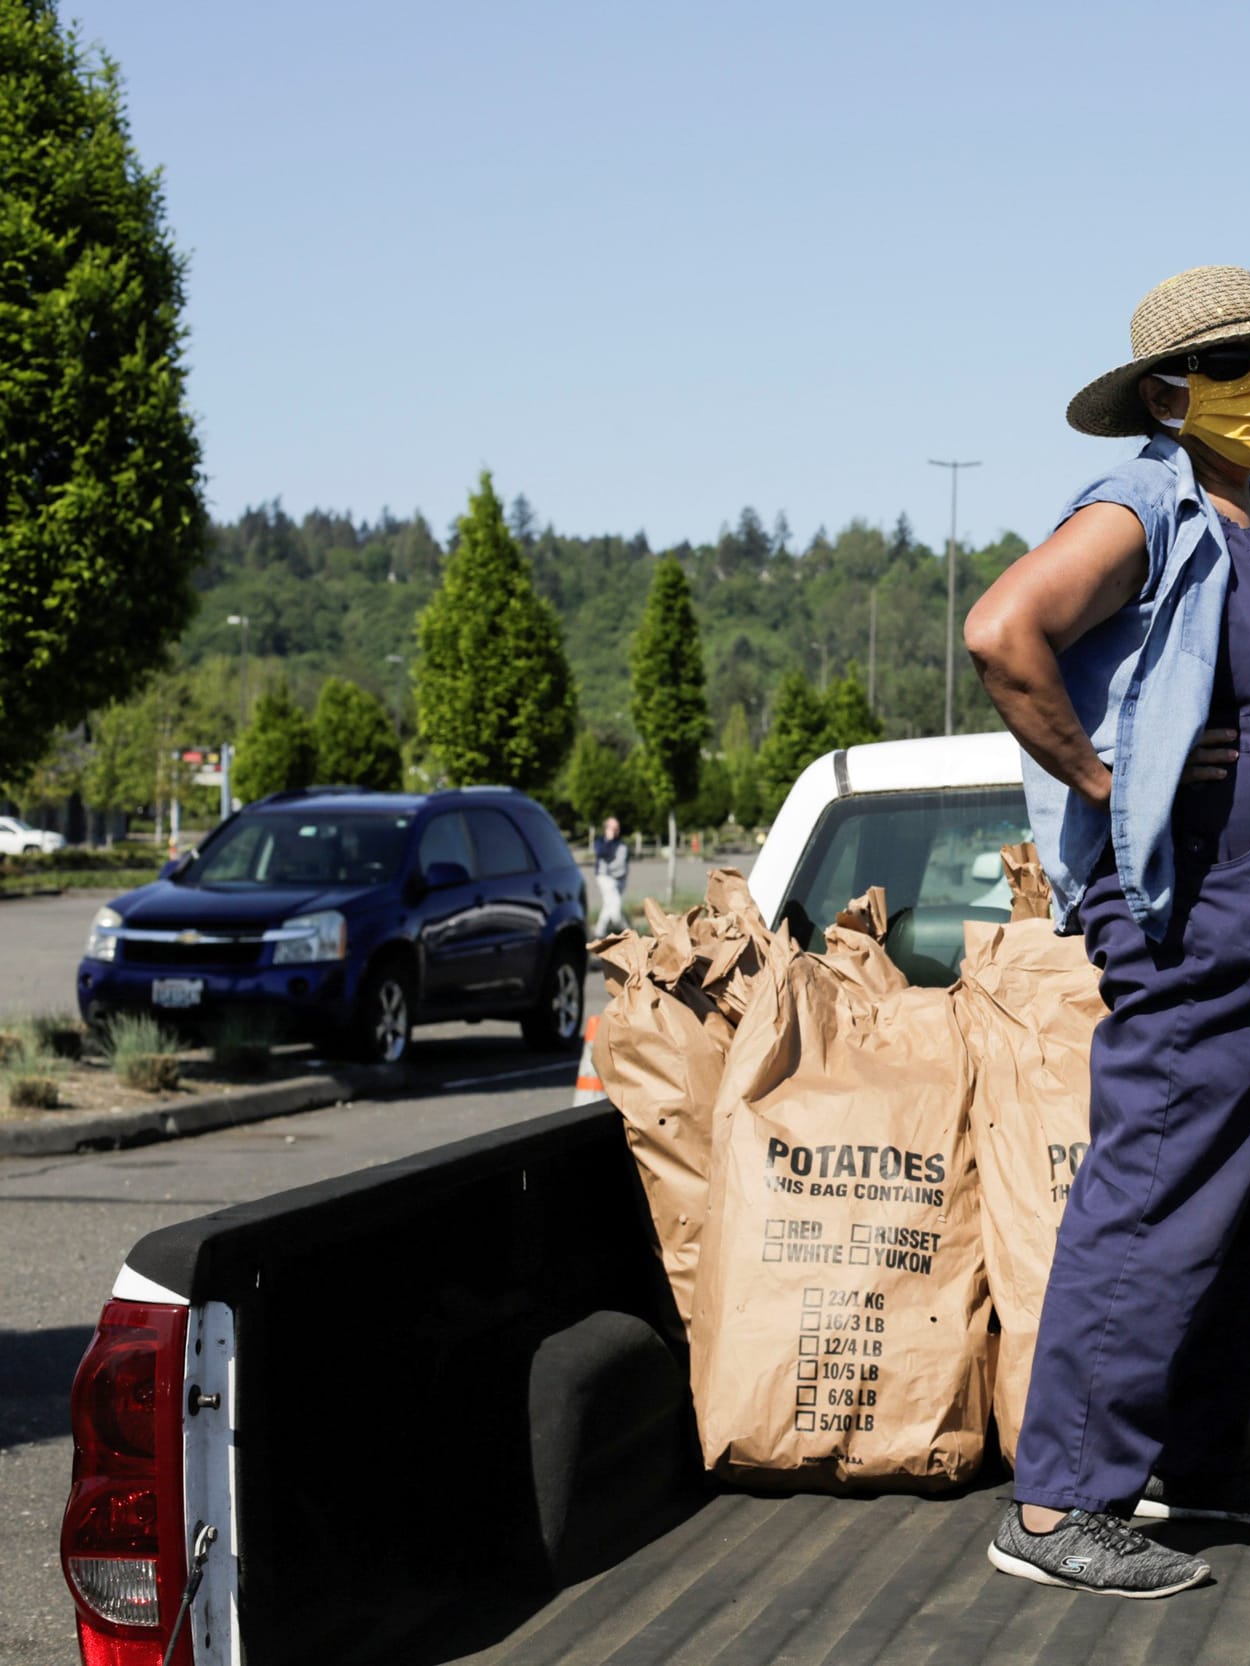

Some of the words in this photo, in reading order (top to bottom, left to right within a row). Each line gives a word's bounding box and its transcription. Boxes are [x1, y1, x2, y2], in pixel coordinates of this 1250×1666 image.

[766, 1137, 945, 1183] POTATOES
[810, 1183, 848, 1197] BAG
[854, 1183, 945, 1208] CONTAINS
[787, 1220, 823, 1240] RED
[874, 1226, 941, 1253] RUSSET
[786, 1244, 843, 1264] WHITE
[874, 1247, 933, 1275] YUKON
[828, 1291, 861, 1307] 23/1
[864, 1292, 884, 1310] KG
[825, 1314, 861, 1332] 16/3
[865, 1316, 885, 1333] LB
[824, 1337, 857, 1355] 12/4
[863, 1340, 882, 1357] LB
[822, 1362, 855, 1380] 10/5
[860, 1364, 879, 1381] LB
[828, 1388, 853, 1406] 6/8
[858, 1389, 876, 1406] LB
[820, 1414, 853, 1432] 5/10
[855, 1414, 874, 1432] LB
